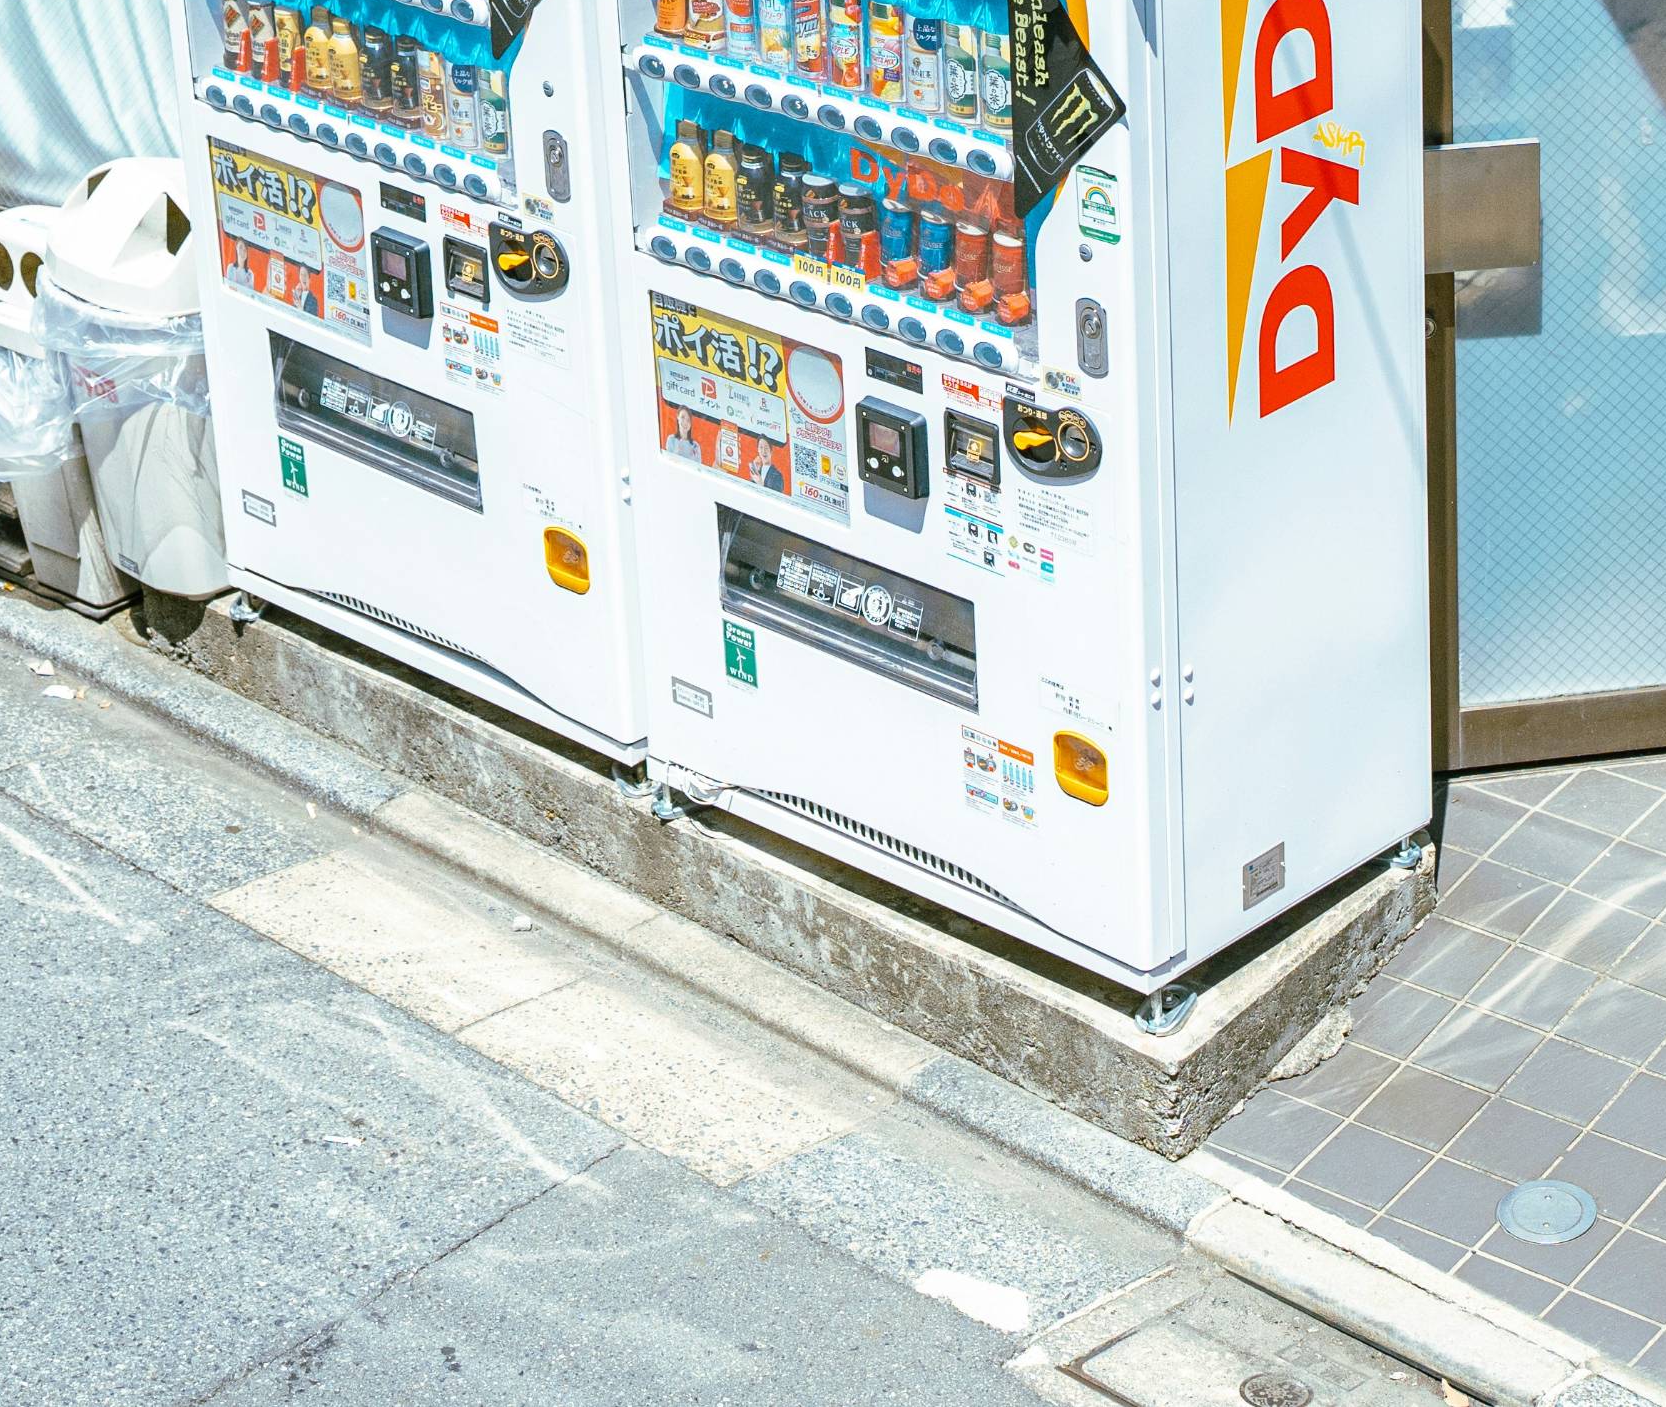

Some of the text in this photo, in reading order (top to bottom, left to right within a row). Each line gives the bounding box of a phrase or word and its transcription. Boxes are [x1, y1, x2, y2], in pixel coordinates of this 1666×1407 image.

[213, 152, 317, 225] ポイ活!?
[850, 147, 966, 212] DyDo
[798, 259, 824, 277] 100円
[834, 271, 862, 290] 100円
[653, 312, 783, 394] ポイ活!?
[665, 380, 696, 398] gift card
[280, 438, 302, 455] Green
[280, 445, 303, 462] Power
[285, 478, 306, 493] WIND
[725, 622, 752, 640] Green
[725, 630, 753, 648] Power
[729, 666, 754, 683] WIND
